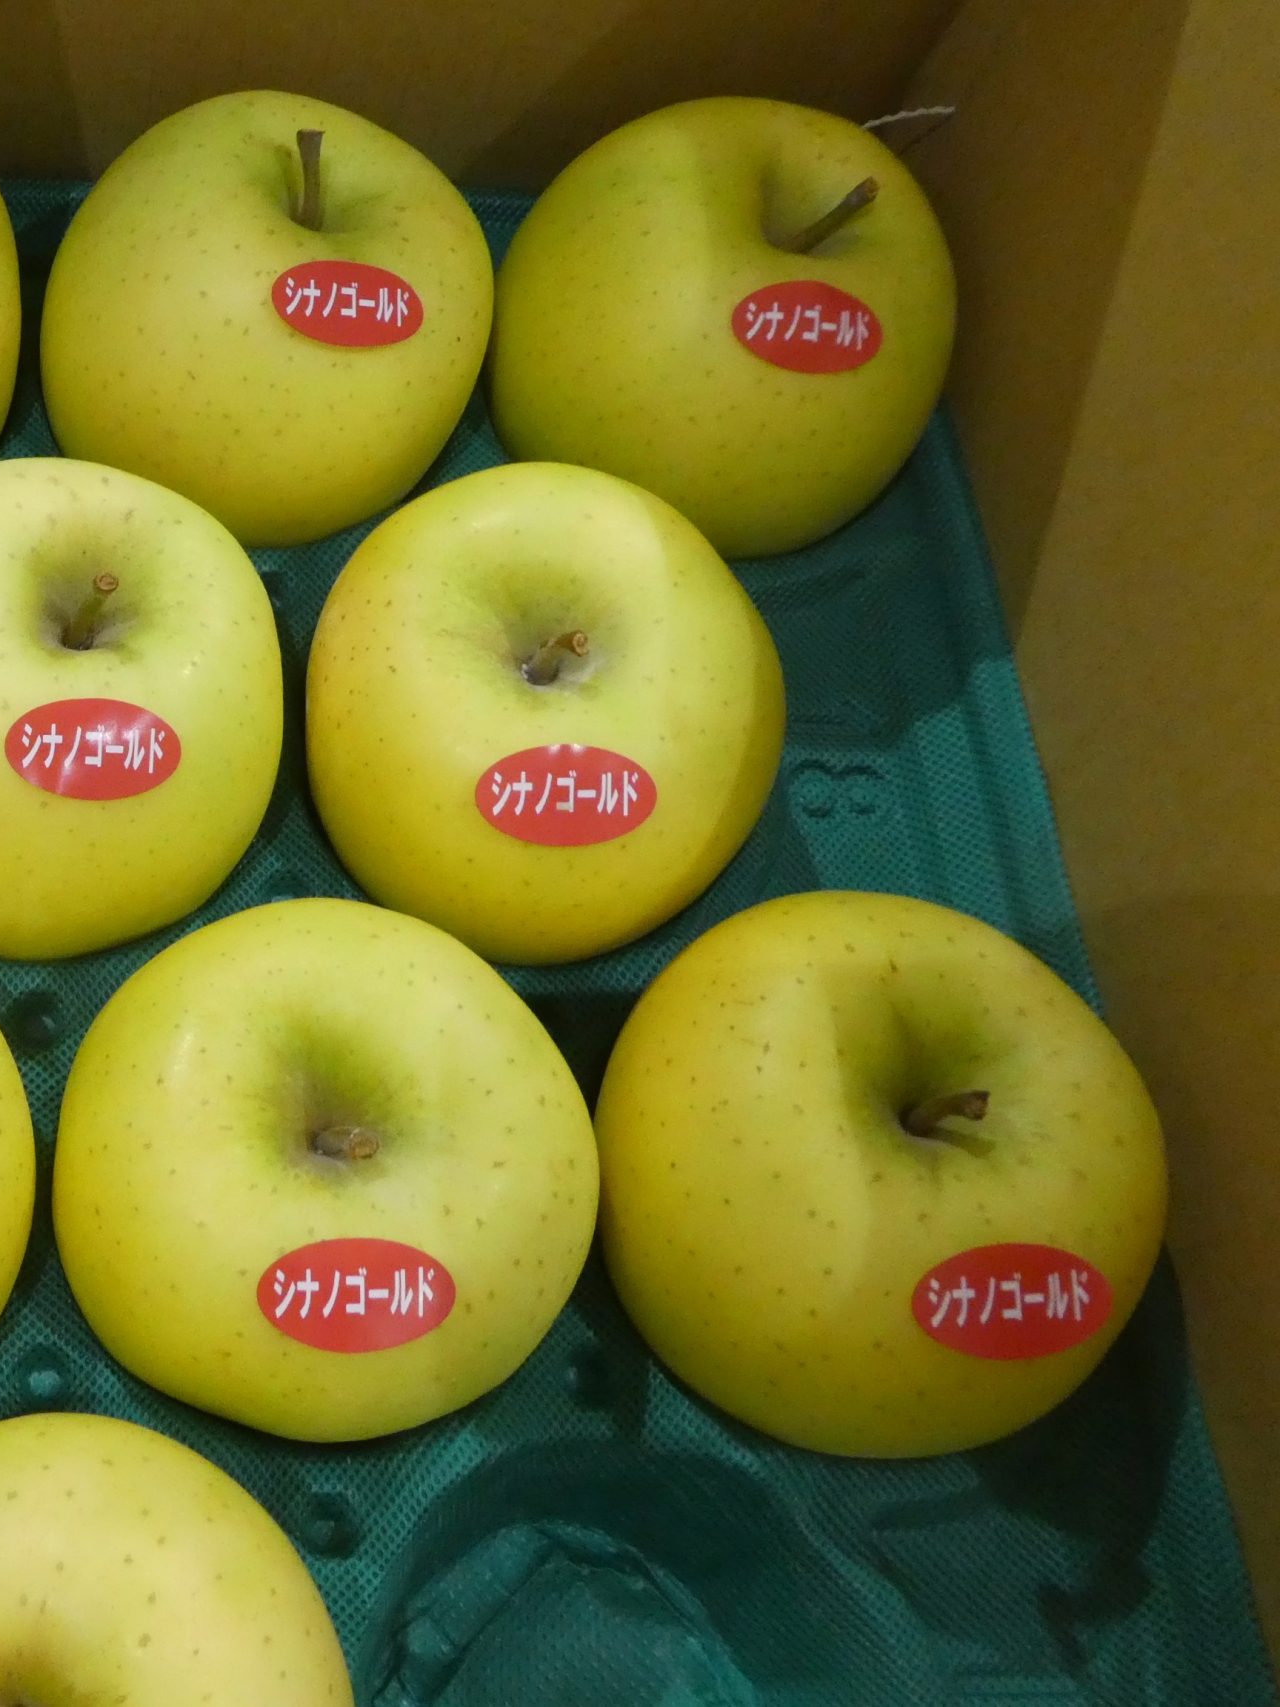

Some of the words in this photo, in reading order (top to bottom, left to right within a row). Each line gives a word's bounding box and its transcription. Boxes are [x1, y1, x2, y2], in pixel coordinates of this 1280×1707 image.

[285, 278, 410, 327] シナノゴールド
[746, 302, 869, 350] シナノゴールド
[22, 722, 165, 774] シナノゴールド
[492, 768, 638, 817] シナノゴールド
[274, 1265, 434, 1318] シナノゴールド
[928, 1270, 1089, 1327] シナノゴールド
